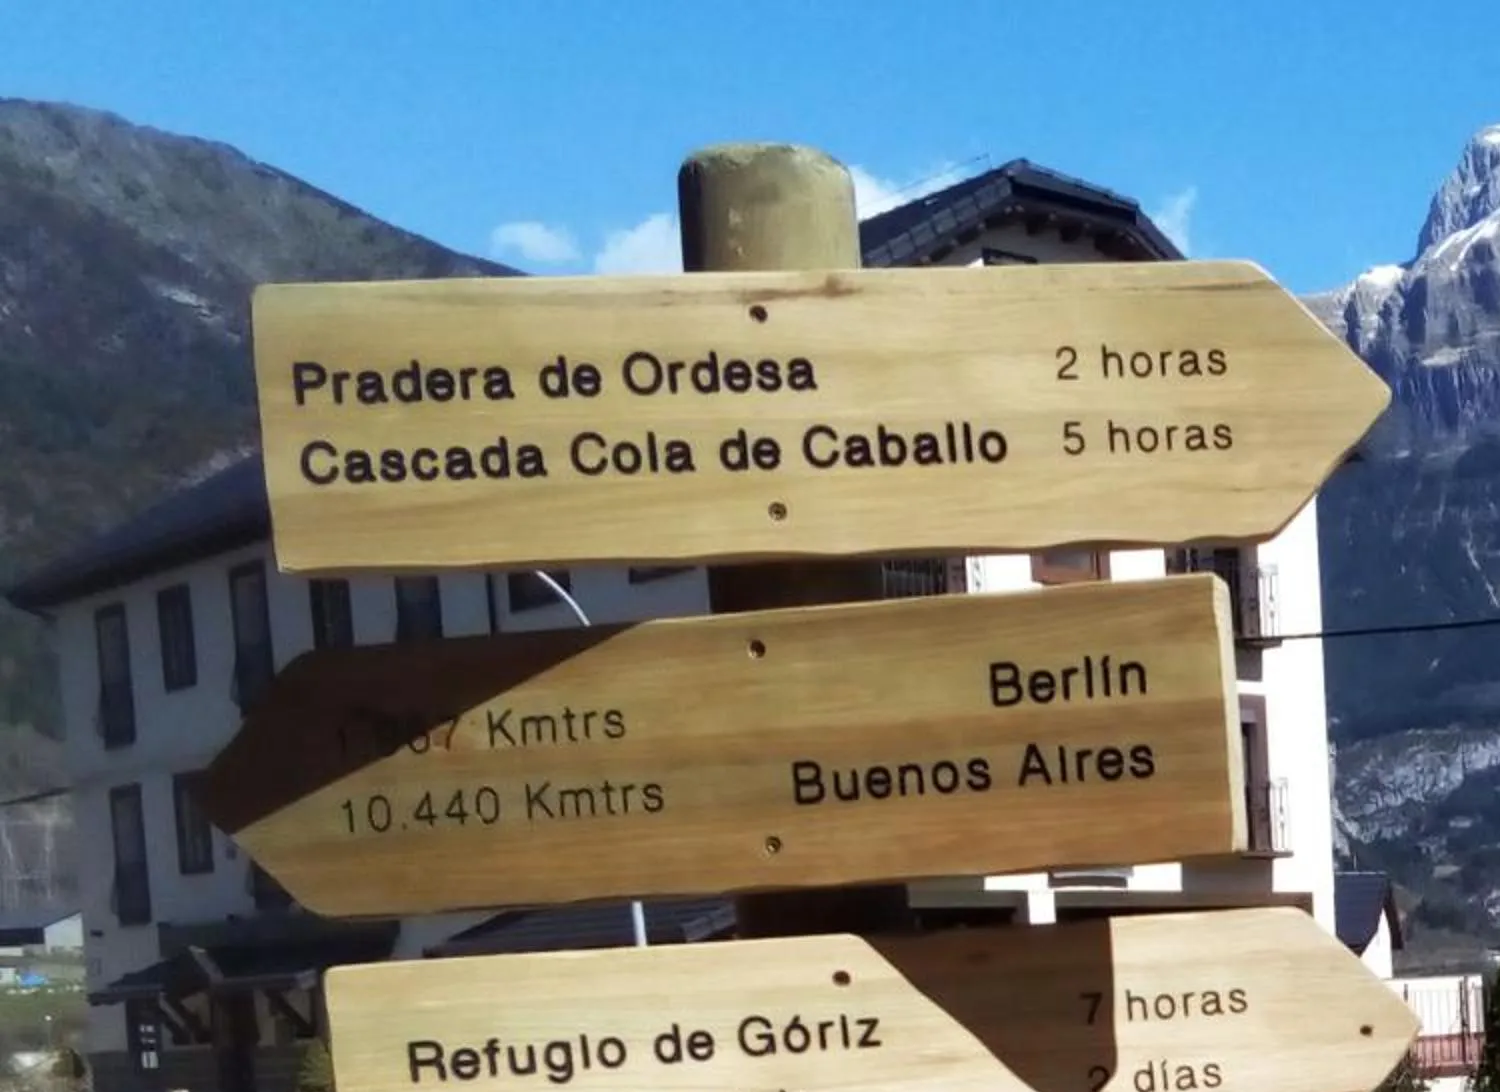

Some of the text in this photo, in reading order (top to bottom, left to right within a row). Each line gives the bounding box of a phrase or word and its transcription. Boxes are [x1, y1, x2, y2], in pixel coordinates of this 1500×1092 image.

[292, 349, 819, 407] Pradera de Ordesa
[1055, 343, 1228, 381] 2 horas
[299, 421, 1008, 486] Cascada Cola de Caballo
[1063, 419, 1233, 456] 5 horas
[989, 655, 1147, 708] Berlín
[487, 707, 625, 747] Kmtrs
[792, 743, 1155, 806] Buenos Aires
[342, 781, 664, 833] 10.440 Kmtrs
[1078, 988, 1249, 1026] 7 horas
[406, 1013, 883, 1085] Refugio de Góriz
